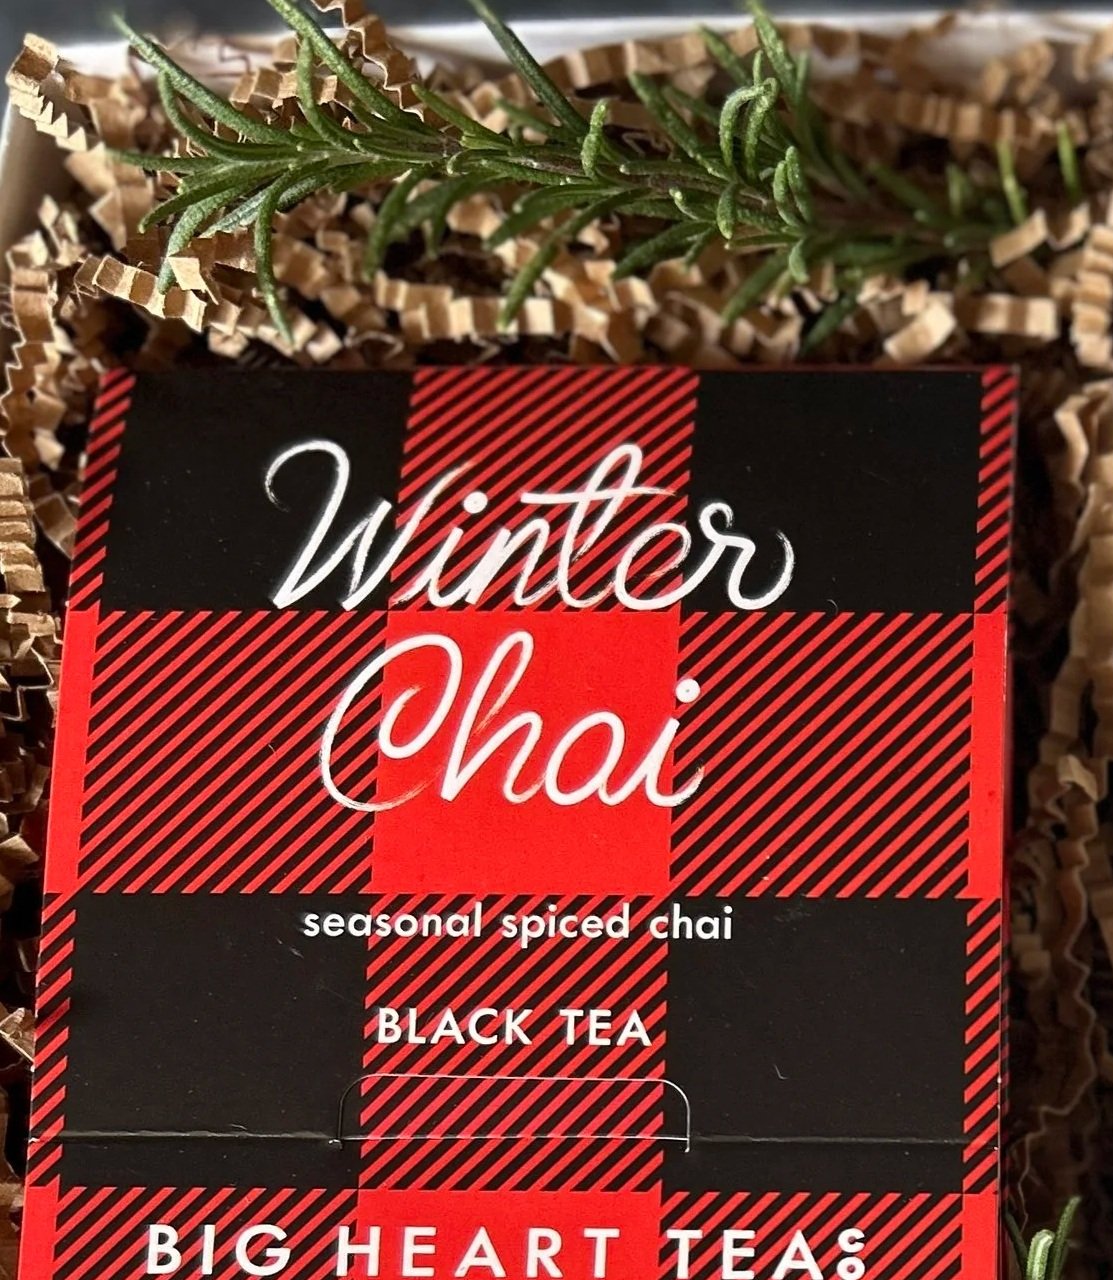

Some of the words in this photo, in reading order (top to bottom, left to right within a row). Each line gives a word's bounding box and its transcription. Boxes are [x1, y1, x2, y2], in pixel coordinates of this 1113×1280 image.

[264, 440, 795, 612] Winter
[319, 630, 705, 812] Chai
[302, 901, 483, 939] seasonal
[500, 903, 631, 948] spiced
[648, 905, 734, 941] chai
[375, 1007, 533, 1046] BLACK
[559, 1008, 653, 1047] TEA
[145, 1223, 291, 1276] BIG
[336, 1225, 621, 1279] HEART
